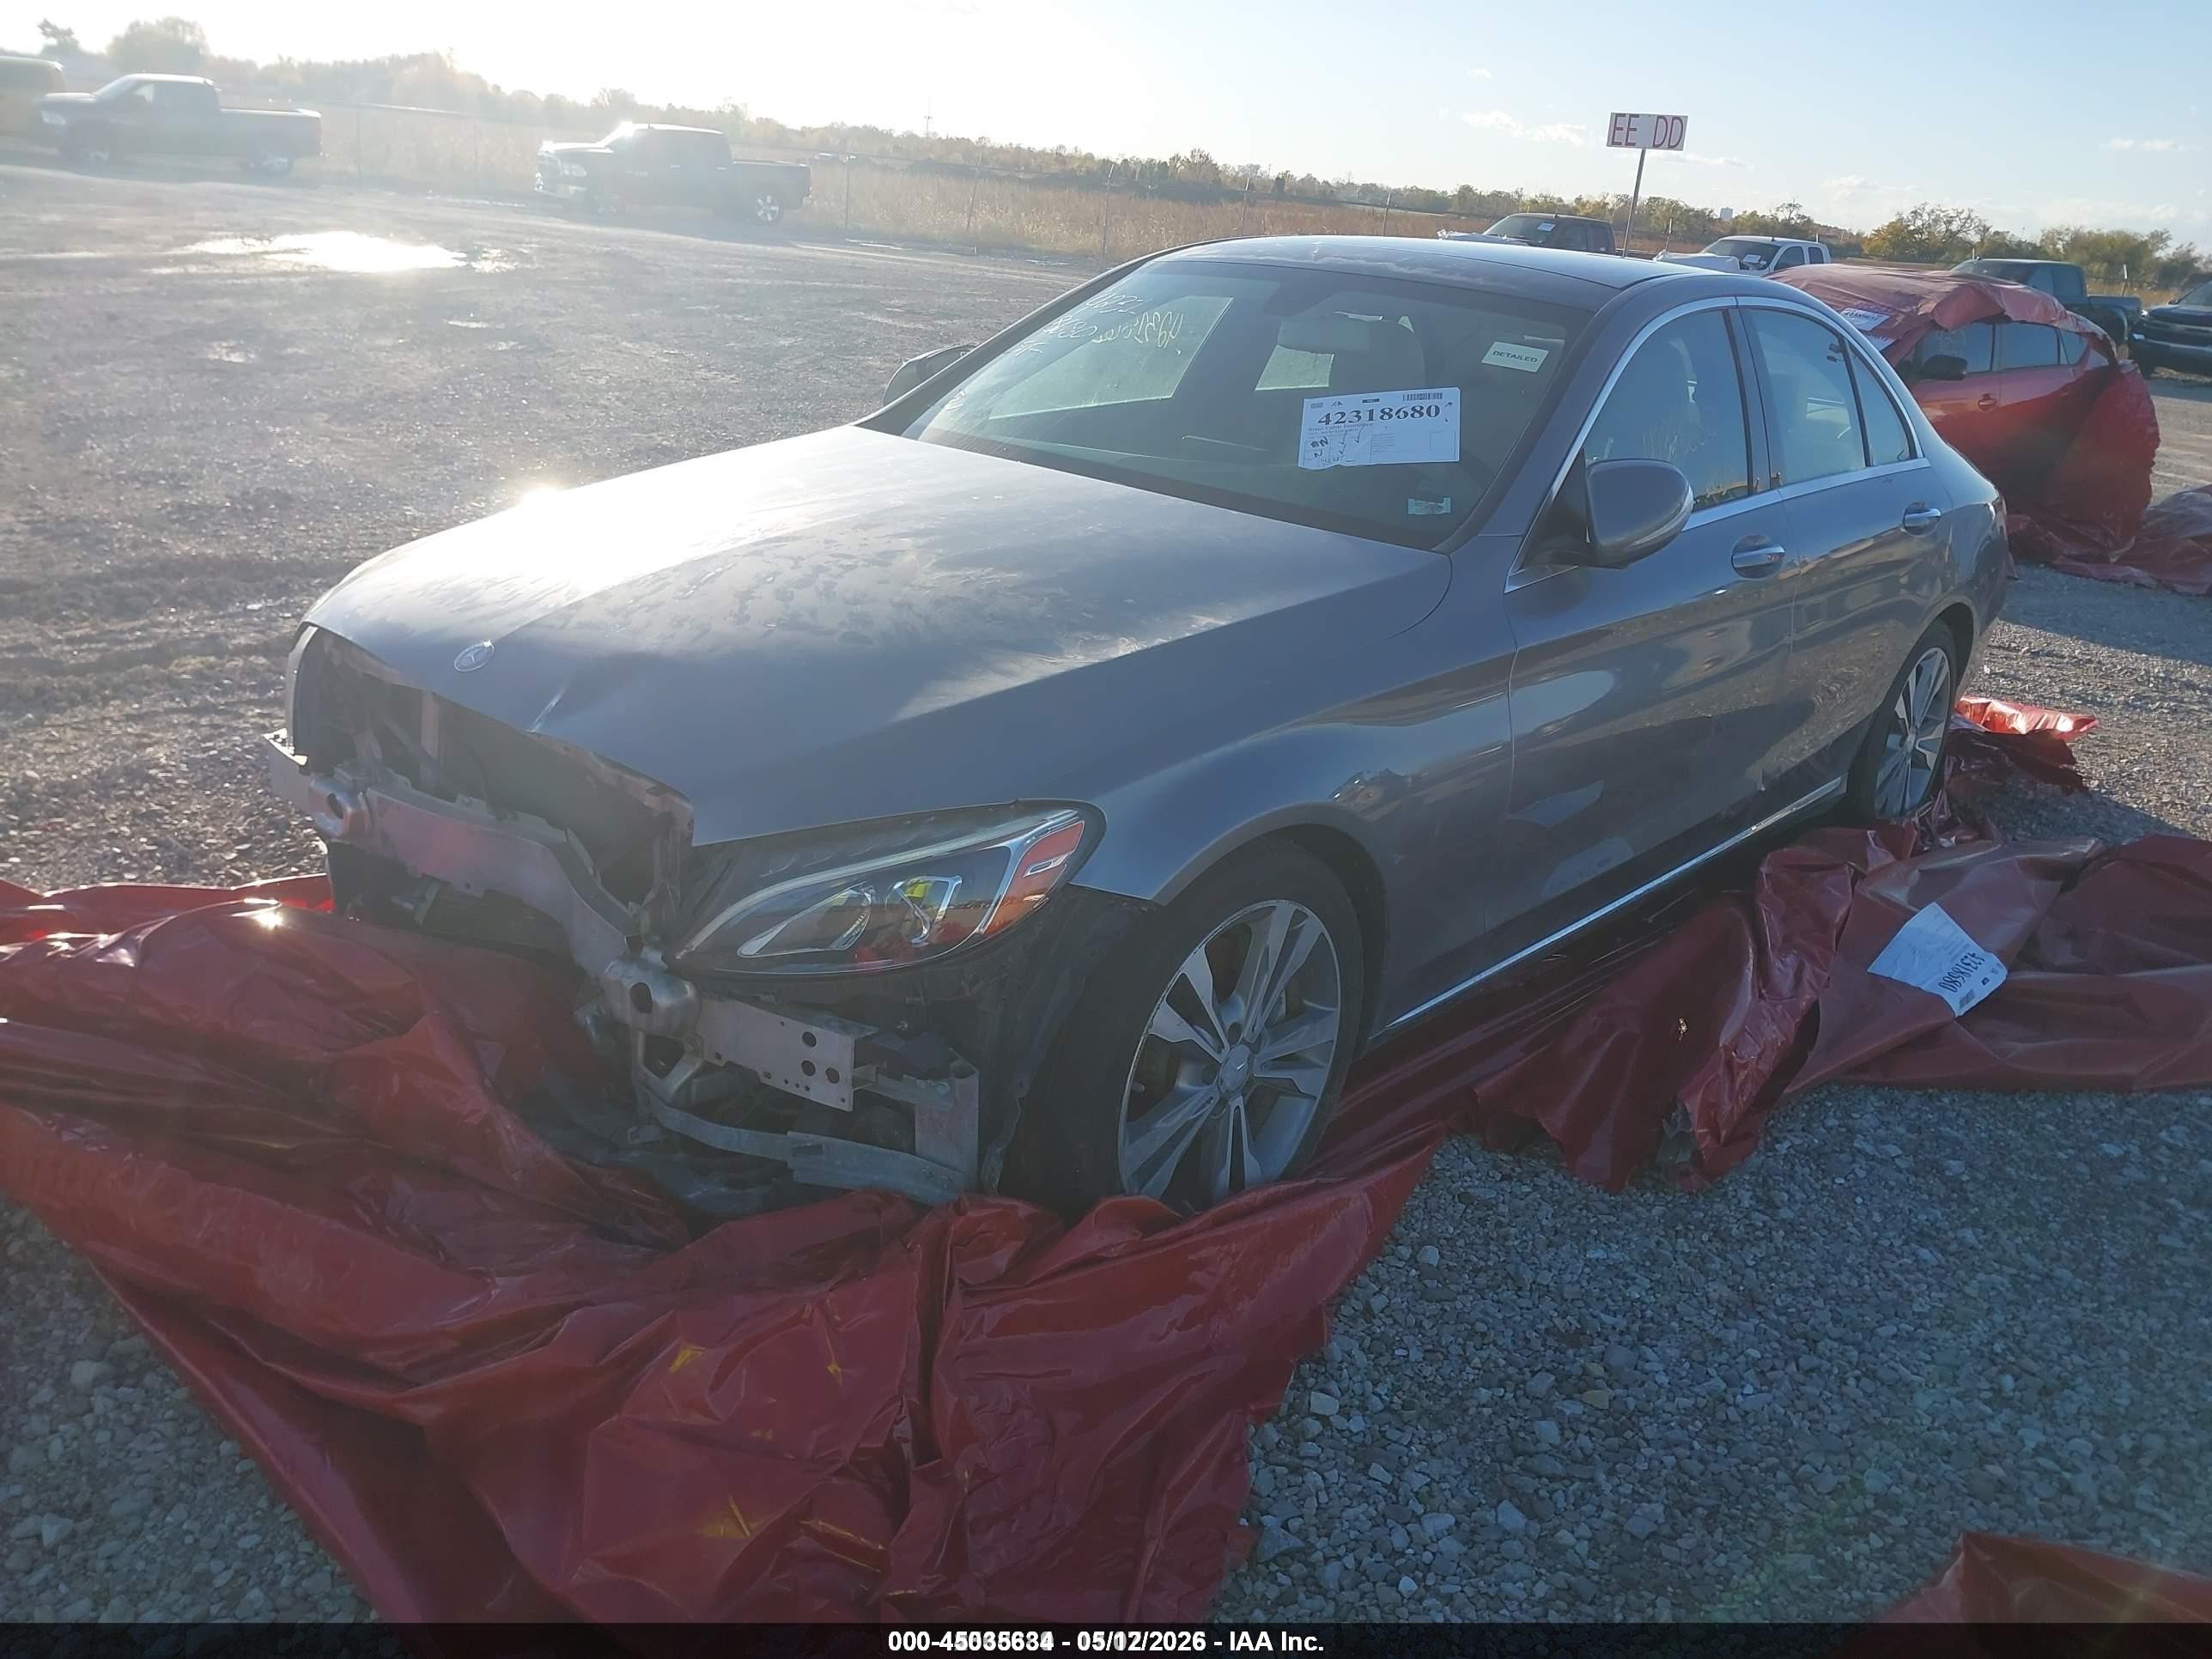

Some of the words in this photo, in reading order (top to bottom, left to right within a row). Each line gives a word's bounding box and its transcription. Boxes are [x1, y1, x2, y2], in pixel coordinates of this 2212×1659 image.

[1611, 112, 1640, 146] EE
[1652, 115, 1684, 149] DD
[1492, 349, 1538, 363] DETAILED
[1317, 404, 1441, 426] 42318680
